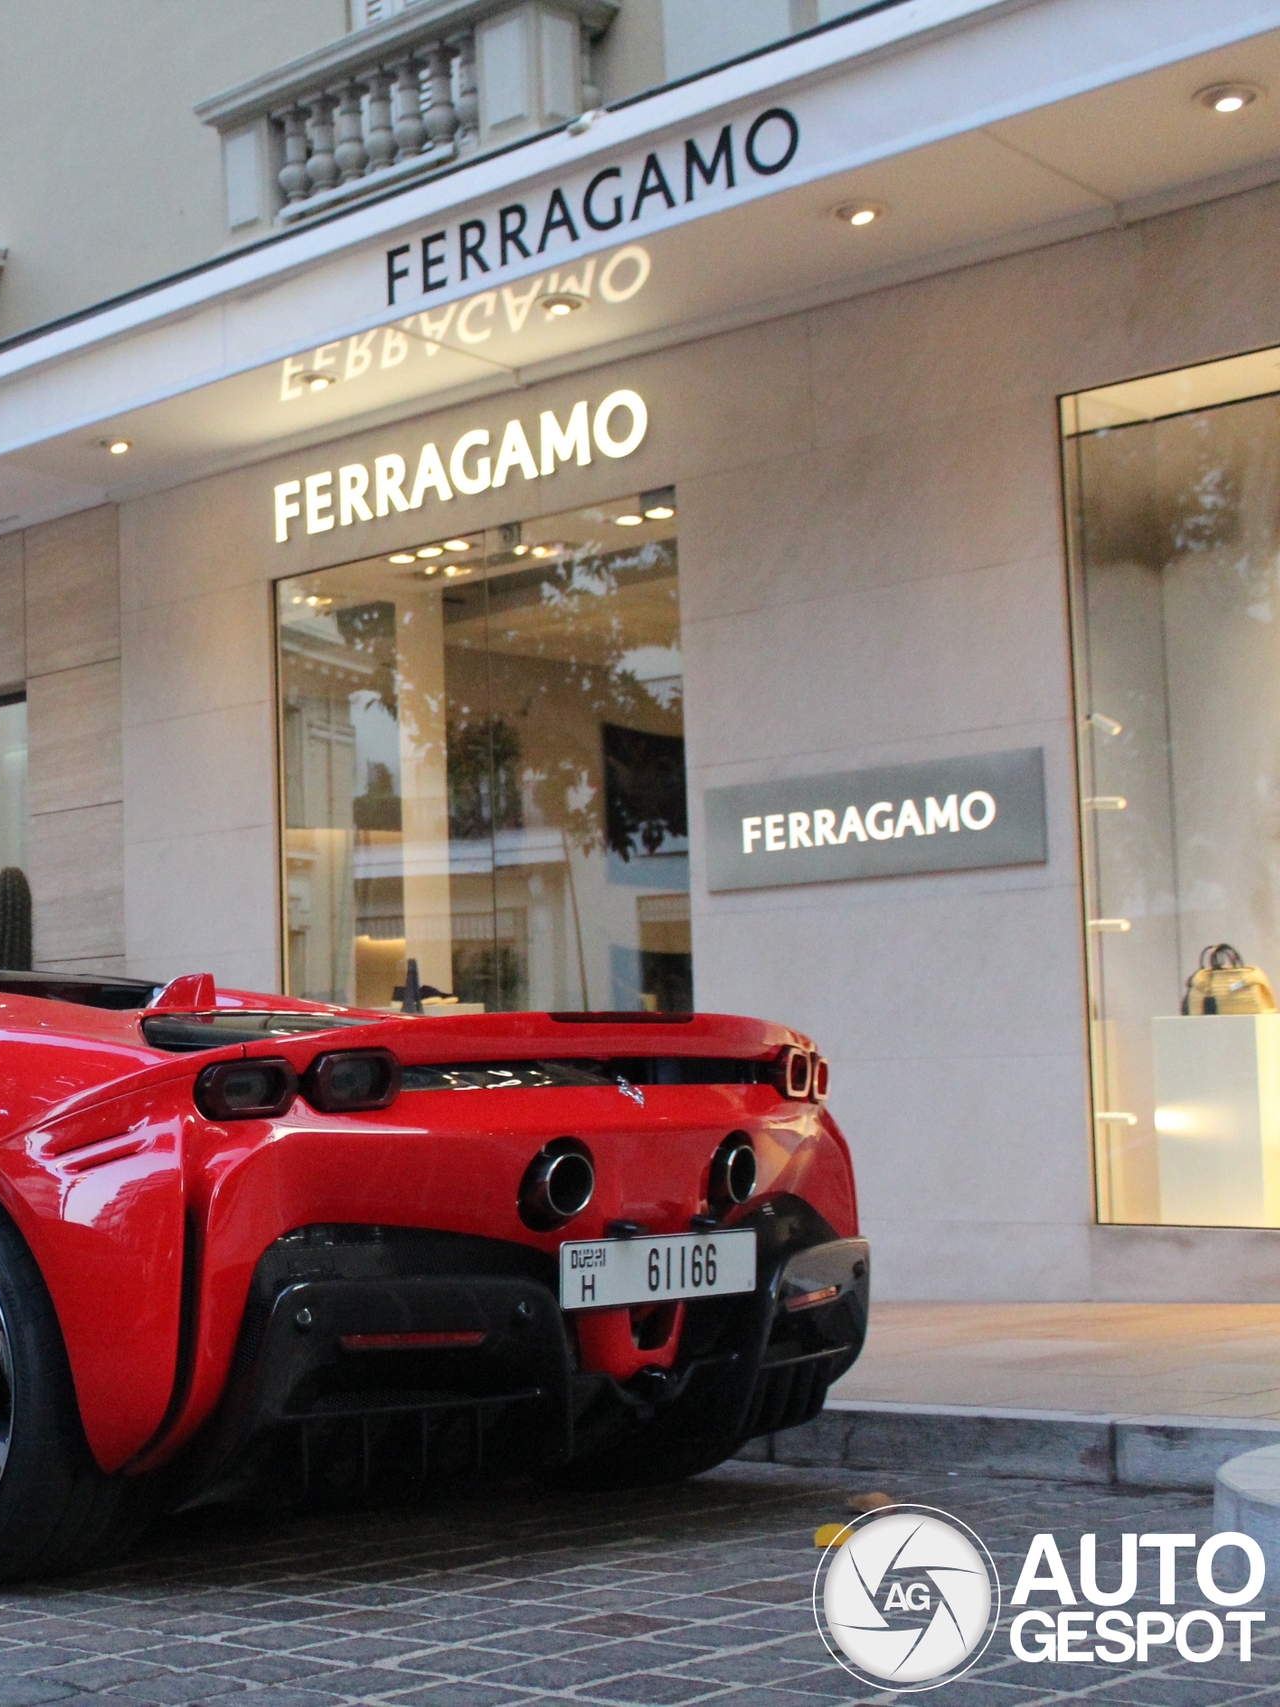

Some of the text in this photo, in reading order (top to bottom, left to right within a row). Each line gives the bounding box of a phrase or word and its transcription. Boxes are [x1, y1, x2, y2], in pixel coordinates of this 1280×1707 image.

[386, 107, 799, 307] FERRAGAMO
[274, 389, 648, 543] FERRAGAMO
[742, 790, 996, 854] FERRAGAMO
[582, 1274, 595, 1302] H
[648, 1243, 717, 1292] 61166
